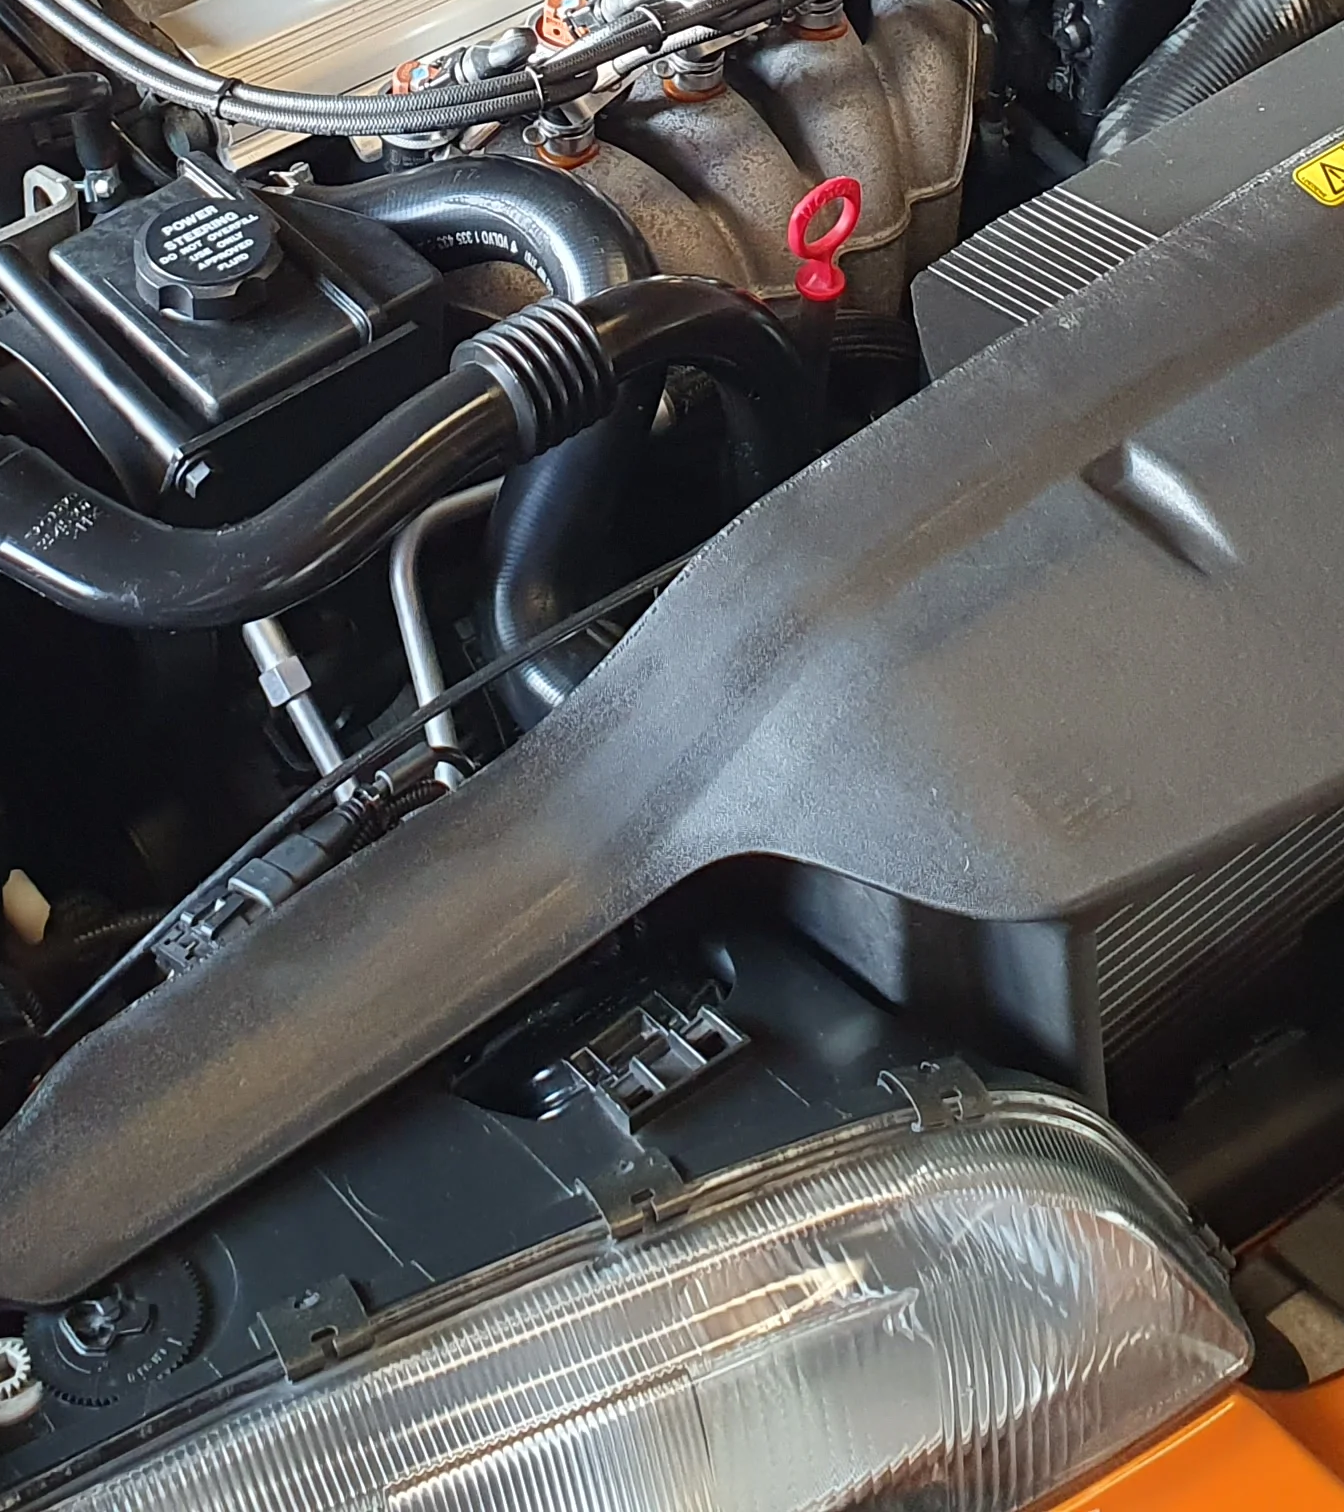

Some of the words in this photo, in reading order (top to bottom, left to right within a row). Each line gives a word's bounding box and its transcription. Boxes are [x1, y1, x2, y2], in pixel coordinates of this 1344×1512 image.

[161, 205, 218, 236] POWER
[163, 211, 239, 251] STEERING
[159, 253, 178, 265] DO
[179, 239, 203, 255] NOT
[207, 214, 259, 242] OVERFILL
[189, 247, 214, 262] USE
[216, 231, 244, 249] ONLY
[198, 238, 254, 271] APPROVED
[217, 252, 250, 271] FLUID
